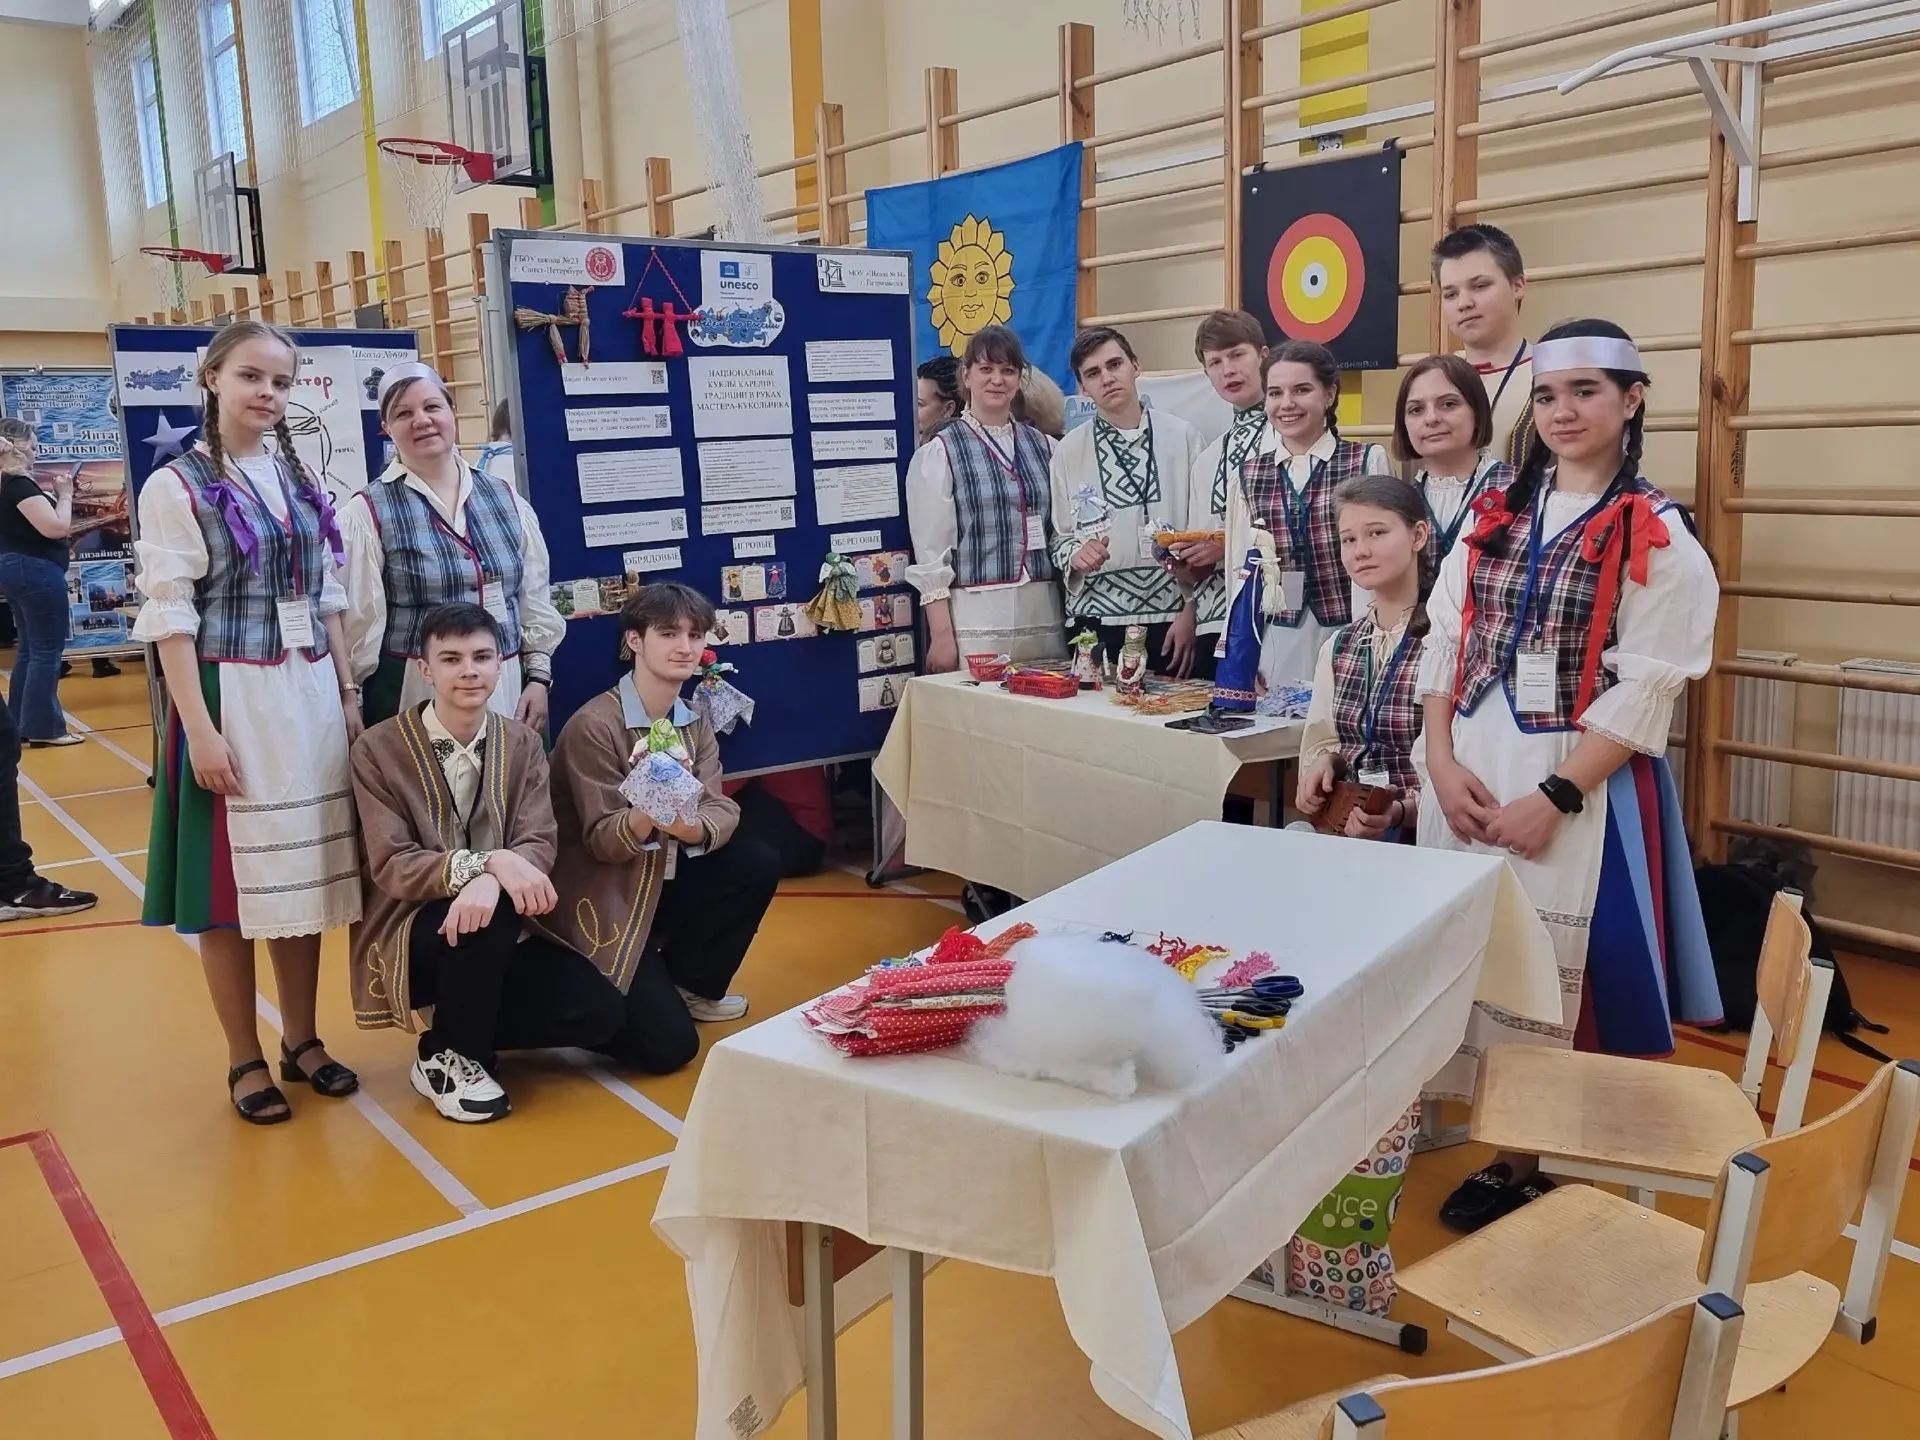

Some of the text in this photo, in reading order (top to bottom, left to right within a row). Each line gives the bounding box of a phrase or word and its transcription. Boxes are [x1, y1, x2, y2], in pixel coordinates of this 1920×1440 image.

[514, 254, 536, 262] ГБОУ
[521, 266, 585, 276] Санкт-Петербург
[720, 280, 759, 290] unesco
[708, 369, 775, 378] НАЦИОНАЛЬНЫЕ
[291, 376, 334, 400] ктор
[708, 380, 736, 388] КУКЛЫ
[704, 391, 782, 400] ТРАДИЦИИ В РУКАХ
[697, 401, 790, 411] МАСТЕРА-КУКОЛЬНИКА
[734, 540, 773, 550] ИГРОВЫЕ
[624, 552, 680, 566] ОБРЯДОВЫЕ
